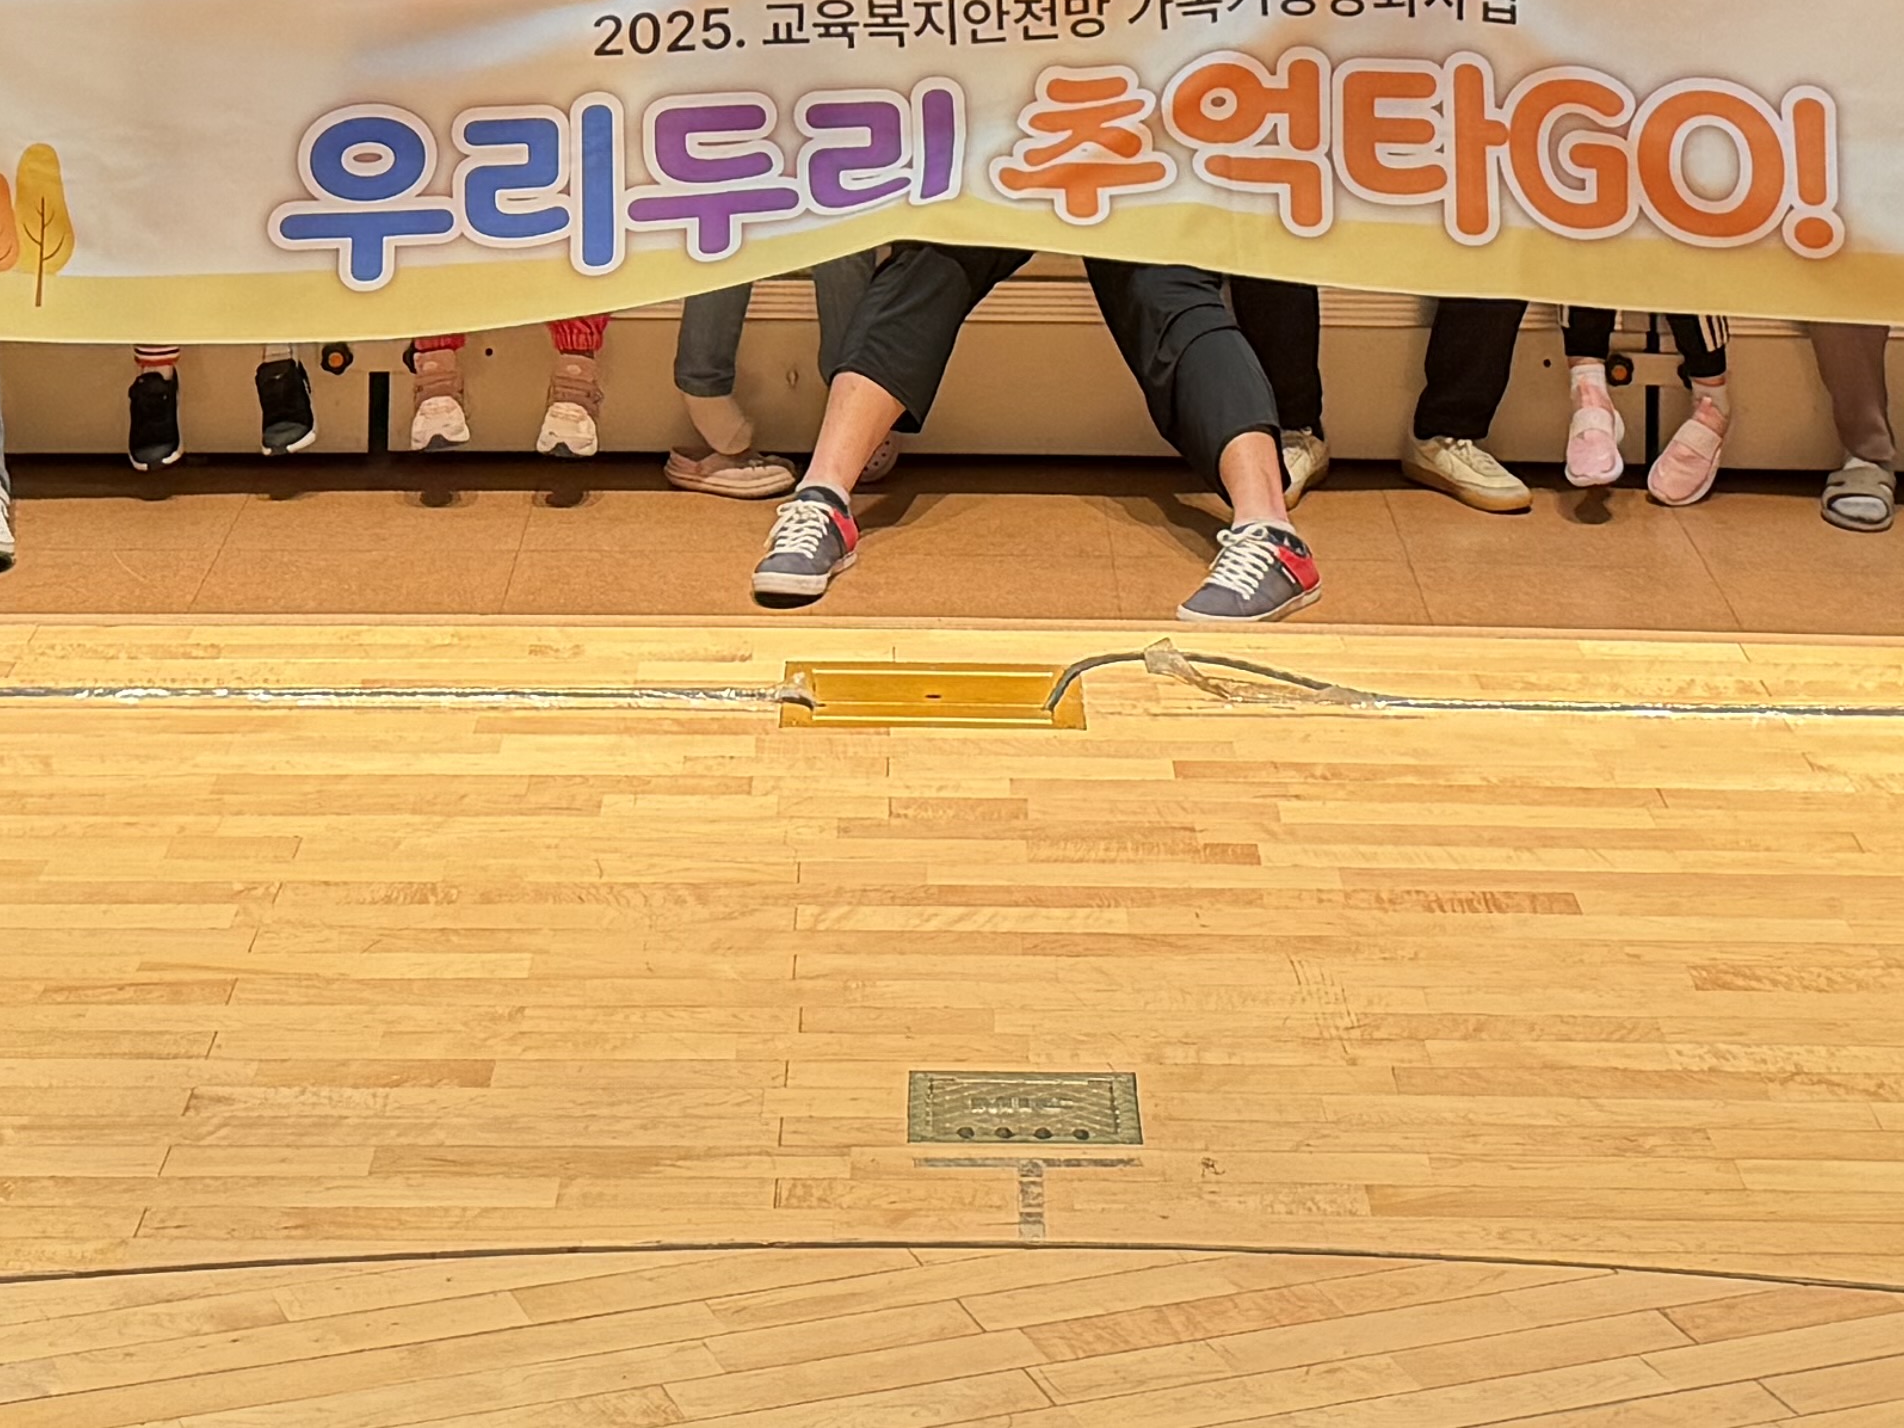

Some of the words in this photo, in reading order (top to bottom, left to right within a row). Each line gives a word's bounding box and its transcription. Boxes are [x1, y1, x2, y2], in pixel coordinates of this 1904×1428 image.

[592, 8, 747, 57] 2025.
[277, 88, 955, 284] 우리두리
[996, 55, 1837, 251] 추억타GO!
